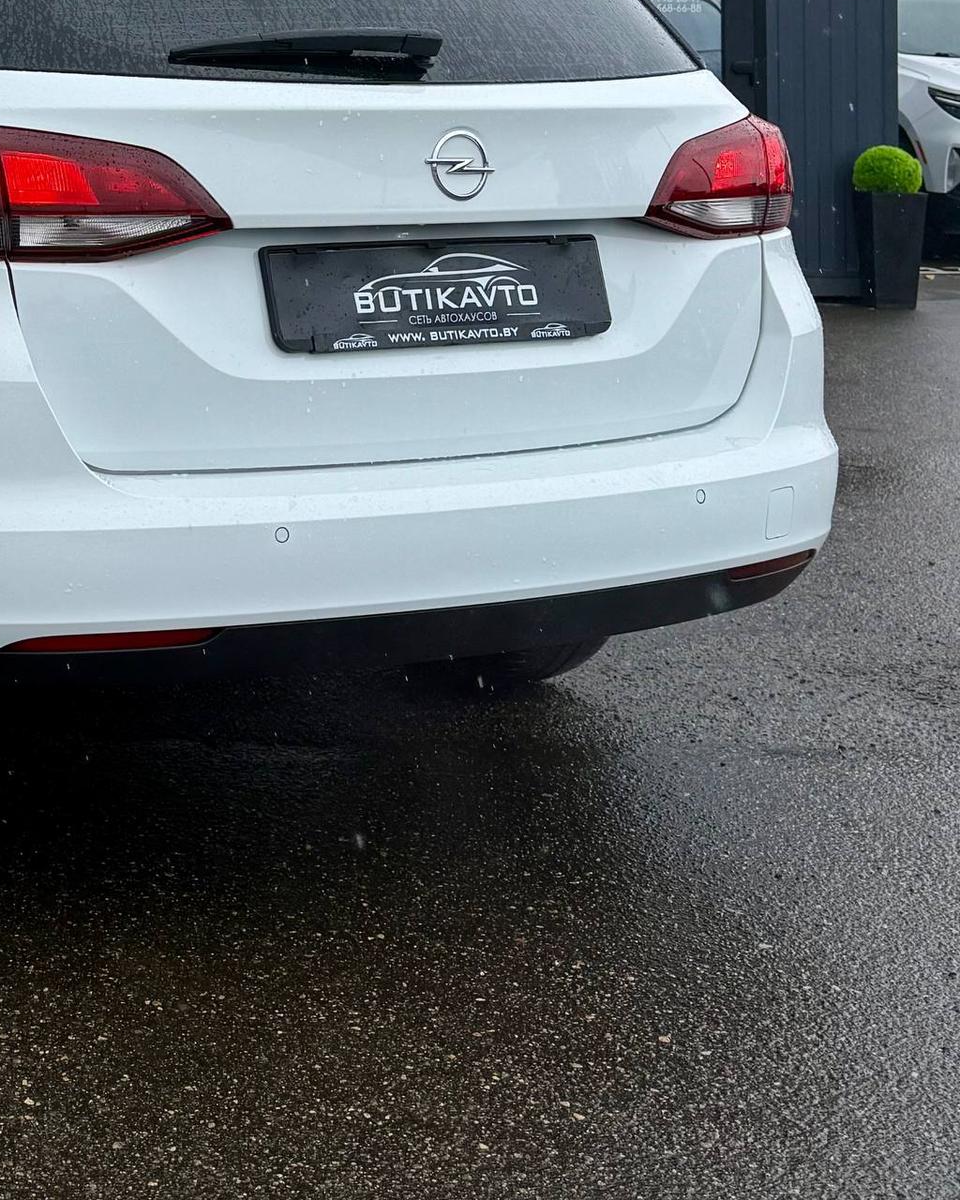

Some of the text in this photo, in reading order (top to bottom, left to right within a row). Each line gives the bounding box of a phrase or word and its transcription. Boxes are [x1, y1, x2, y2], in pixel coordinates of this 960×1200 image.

[353, 284, 538, 315] BUTIKAVTO
[409, 311, 498, 325] СЕТЬ АВТОХАУСОВ
[388, 327, 518, 343] WWW. BUTIKAVTO.BY
[531, 329, 571, 339] BUTIKAVTO
[333, 339, 378, 350] BUTIKAVTO
